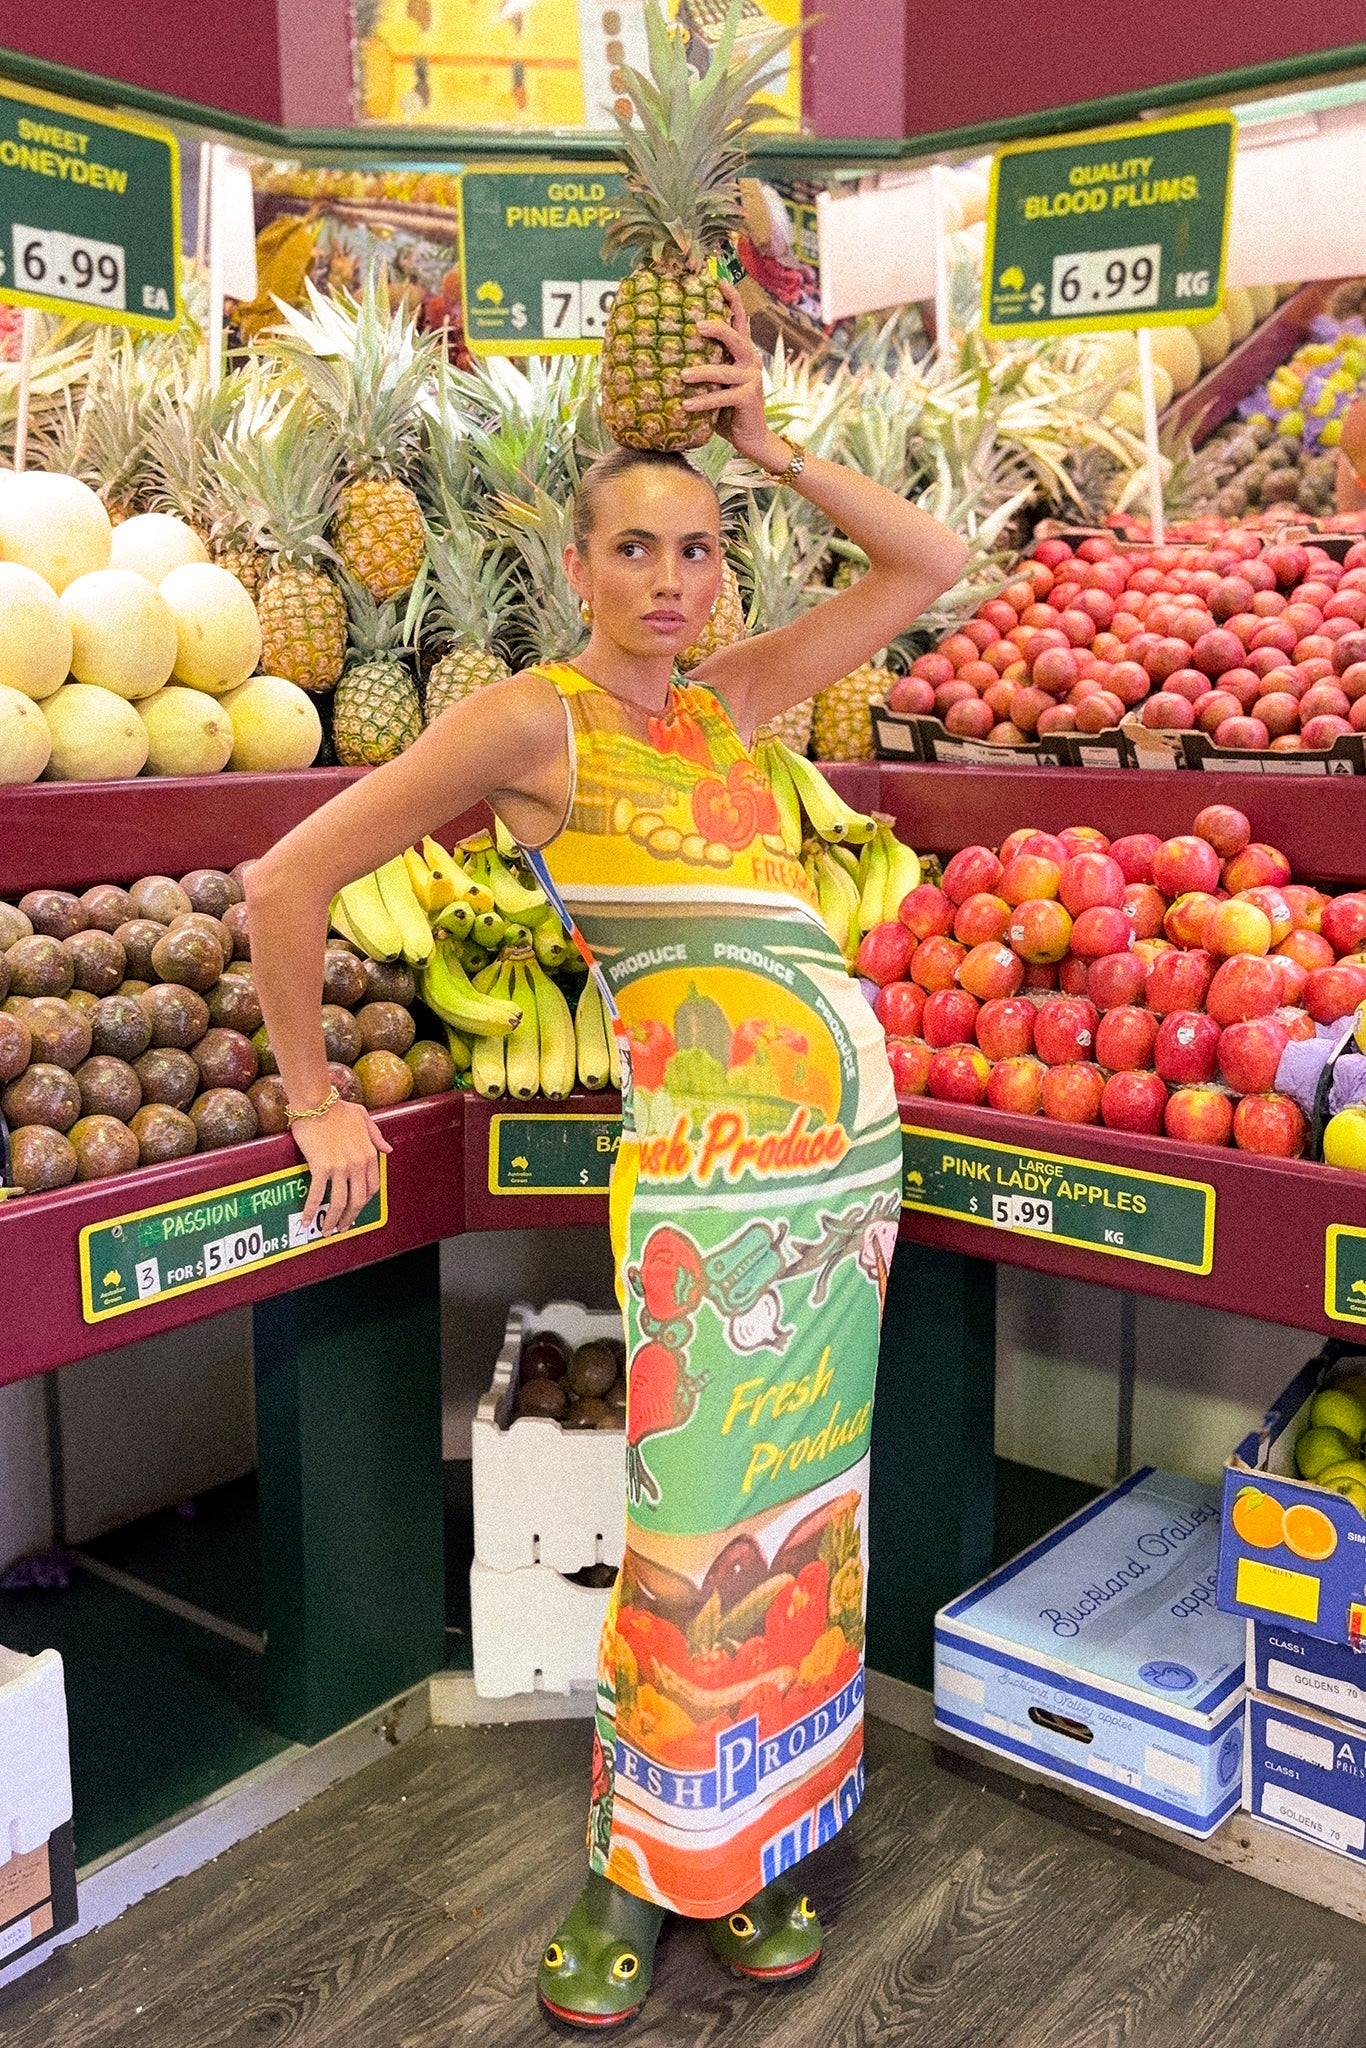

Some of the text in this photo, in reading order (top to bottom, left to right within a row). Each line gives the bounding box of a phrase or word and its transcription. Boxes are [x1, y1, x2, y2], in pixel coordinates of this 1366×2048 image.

[17, 118, 90, 155] SWEET
[1069, 157, 1154, 187] QUALITY
[547, 183, 605, 202] GOLD
[1024, 175, 1199, 220] BLOOD PLUMS
[506, 205, 620, 229] PINEAPP
[23, 241, 119, 293] 6.99
[142, 285, 170, 312] EA
[1029, 282, 1045, 315] $
[1060, 257, 1153, 303] 6.99
[1175, 270, 1210, 298] KG
[511, 302, 527, 331] $
[609, 944, 687, 983] PRODUCE
[714, 943, 796, 985] PRODUCE
[815, 996, 858, 1082] PRODUCE
[698, 1108, 845, 1182] Produce
[579, 1168, 589, 1185] $
[1018, 1158, 1064, 1178] LARGE
[942, 1155, 1148, 1215] PINK LADY APPLES
[161, 1178, 308, 1241] PASSION FRUITS
[969, 1196, 1050, 1226] $ 5.99
[1104, 1229, 1125, 1246] KG
[141, 1267, 155, 1290] 3
[167, 1266, 194, 1285] FOR
[195, 1259, 205, 1277] $
[208, 1231, 262, 1271] 5.00
[263, 1236, 279, 1254] OR
[281, 1233, 289, 1249] $
[720, 1345, 836, 1437] Fresh
[740, 1400, 873, 1495] Produce
[1263, 1566, 1294, 1579] VARIETY
[1039, 1555, 1151, 1638] Buckland
[1269, 1637, 1305, 1656] CLASS 1
[1294, 1674, 1359, 1700] GOLDENS 70
[624, 1675, 864, 1807] ESH PRODUC
[1336, 1742, 1355, 1765] A
[1126, 1773, 1133, 1785] 1
[1264, 1760, 1300, 1781] CLASS 1
[1336, 1759, 1365, 1779] PRIES
[1279, 1805, 1341, 1842] GOLDENS 70
